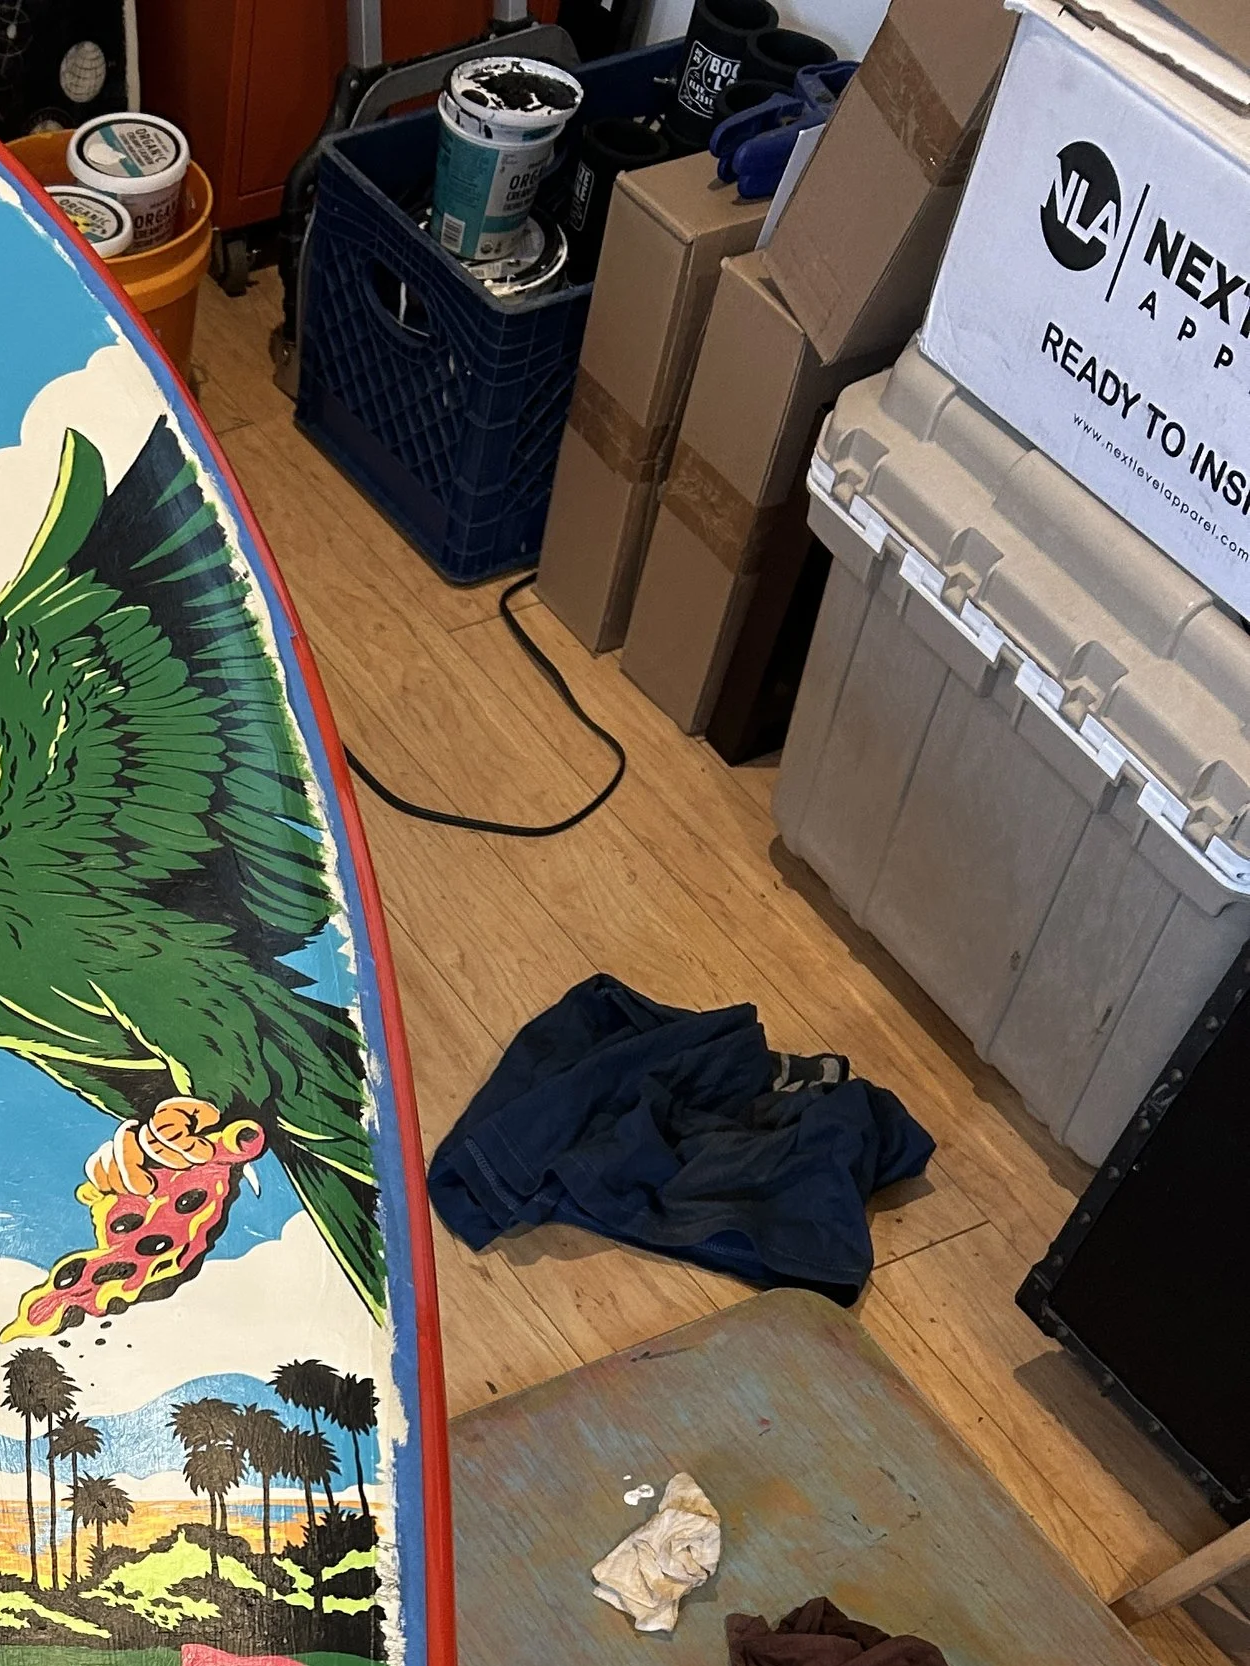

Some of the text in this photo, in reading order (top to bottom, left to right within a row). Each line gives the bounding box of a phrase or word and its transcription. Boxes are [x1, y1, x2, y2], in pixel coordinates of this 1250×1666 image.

[135, 128, 168, 164] ORGANIC
[59, 199, 112, 226] ORGANIC
[1041, 321, 1141, 420] READY
[1147, 402, 1187, 458] TO
[1138, 290, 1250, 395] APP
[1073, 413, 1250, 563] www.nextlevelapparel.com
